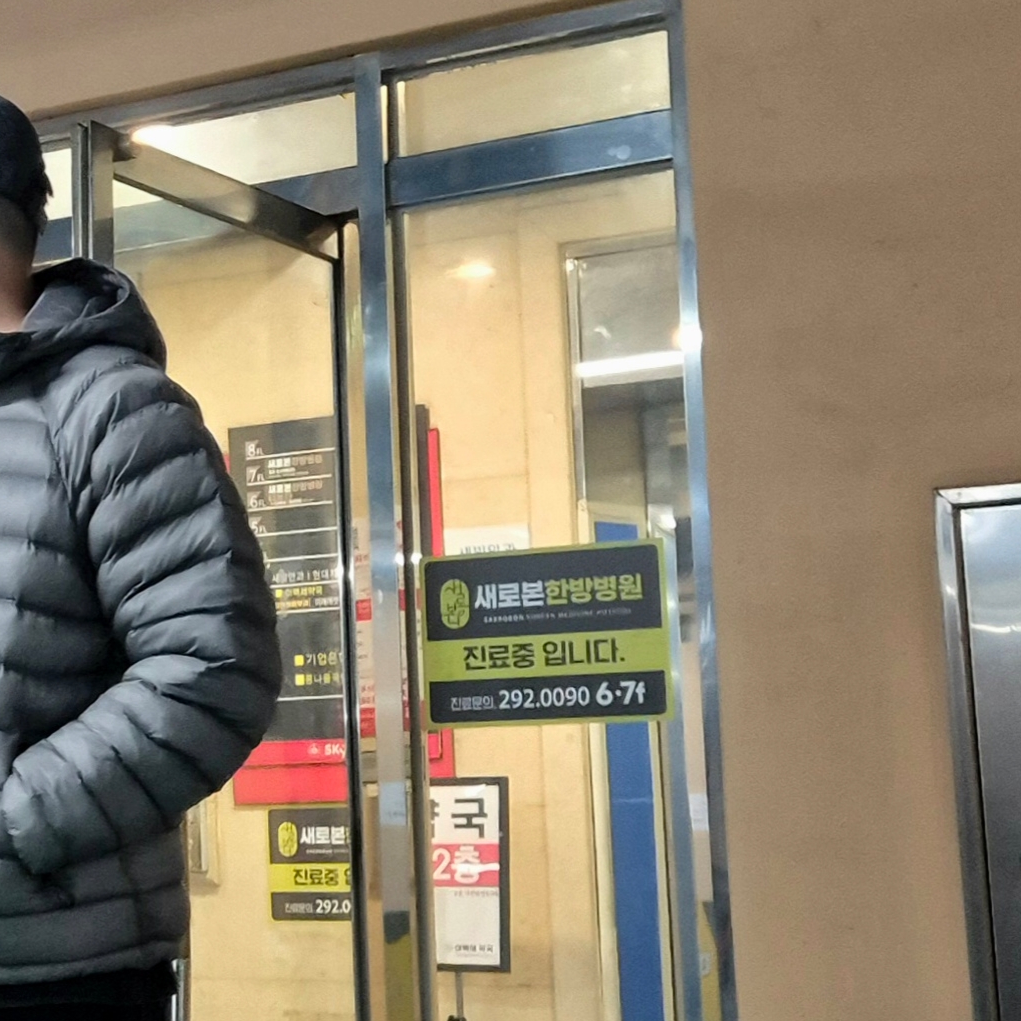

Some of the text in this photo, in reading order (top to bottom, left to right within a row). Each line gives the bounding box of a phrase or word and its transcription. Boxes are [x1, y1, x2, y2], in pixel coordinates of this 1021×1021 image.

[474, 573, 644, 610] 새로본한방병원
[463, 637, 626, 671] 진료중 입니다.
[498, 685, 591, 711] 292.0090
[300, 825, 350, 846] 새로본
[292, 867, 339, 887] 진료중
[432, 844, 481, 884] 2층
